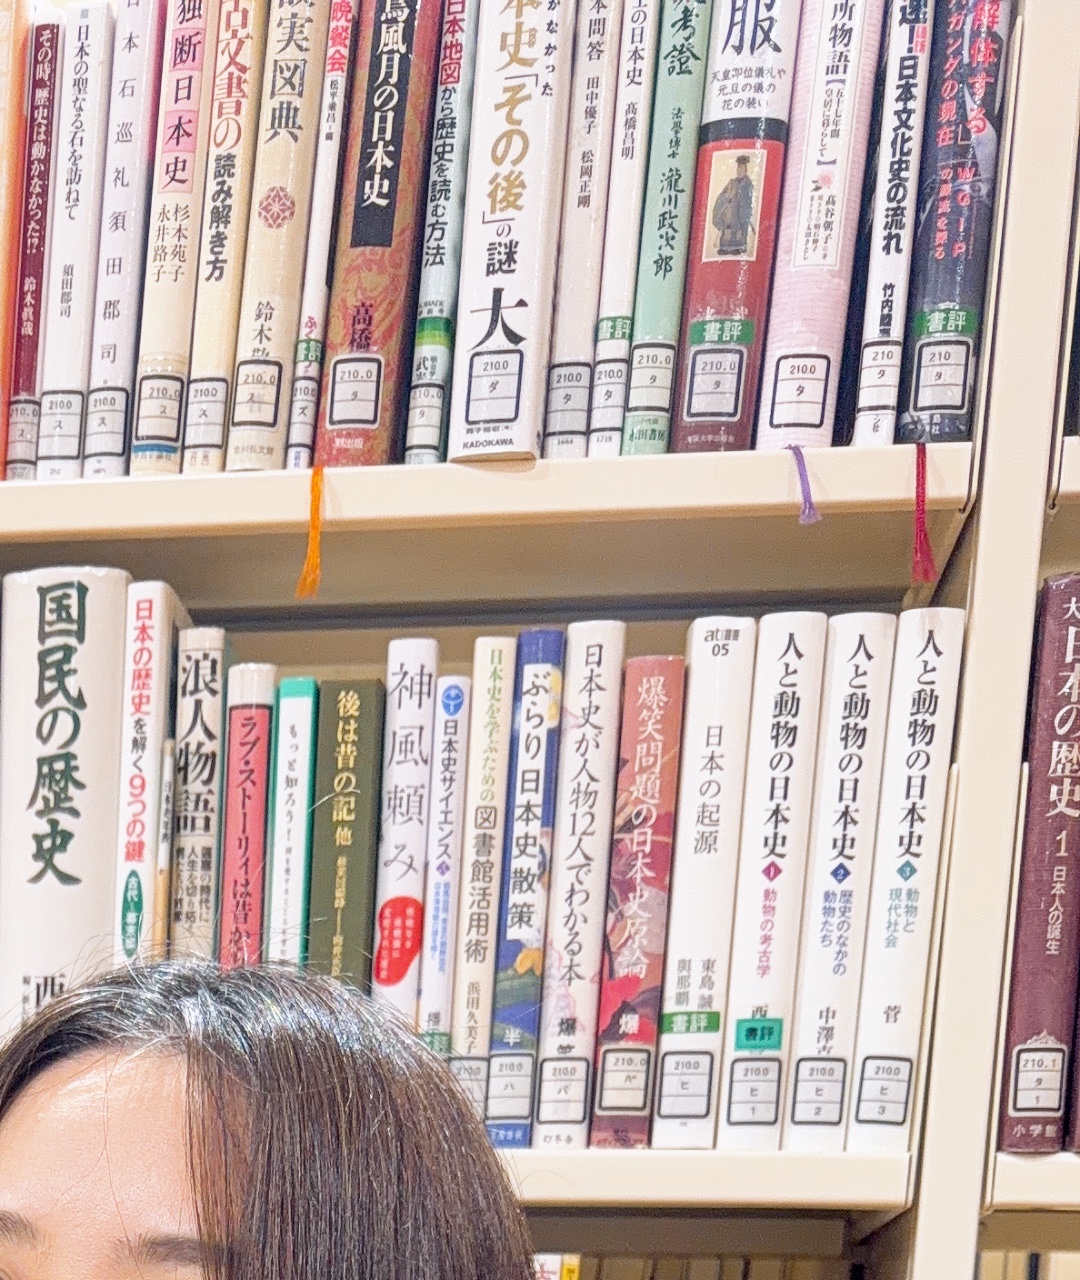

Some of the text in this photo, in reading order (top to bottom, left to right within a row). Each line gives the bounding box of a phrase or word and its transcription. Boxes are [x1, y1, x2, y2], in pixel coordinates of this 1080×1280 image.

[64, 24, 90, 221] 日本の聖なる石を訪ねて
[576, 76, 600, 209] 田中優子 松岡正剛
[151, 207, 171, 283] 永井路子
[168, 204, 191, 283] 杉本苑子
[702, 322, 743, 342] 書評
[926, 310, 967, 332] 書評
[462, 436, 516, 451] KADOKAWA
[711, 644, 729, 657] 05
[26, 580, 90, 886] 国民の歴史
[123, 599, 155, 864] 日本の歴史を解く9つの鍵
[175, 653, 220, 834] 浪人物語
[332, 690, 361, 823] 後は昔の記
[382, 662, 434, 881] 神風頼み
[434, 718, 460, 862] 日本史サイエンス
[693, 725, 724, 854] 日本の起源
[762, 633, 804, 858] 人と動物の日本史
[832, 634, 873, 861] 人と動物の日本史
[897, 629, 942, 859] 人と動物の日本史
[508, 670, 551, 930] ぶらり日本史散策
[558, 643, 606, 985] 日本史が人物12人でわかる本
[619, 676, 669, 981] 爆笑問題の日本史原論
[756, 889, 777, 978] 動物の考古学
[820, 890, 837, 948] 動物たち
[830, 890, 853, 976] 歴史のなかの
[884, 888, 902, 948] 現代社会
[902, 888, 919, 934] 動物と
[1045, 865, 1067, 956] 日本人の誕生
